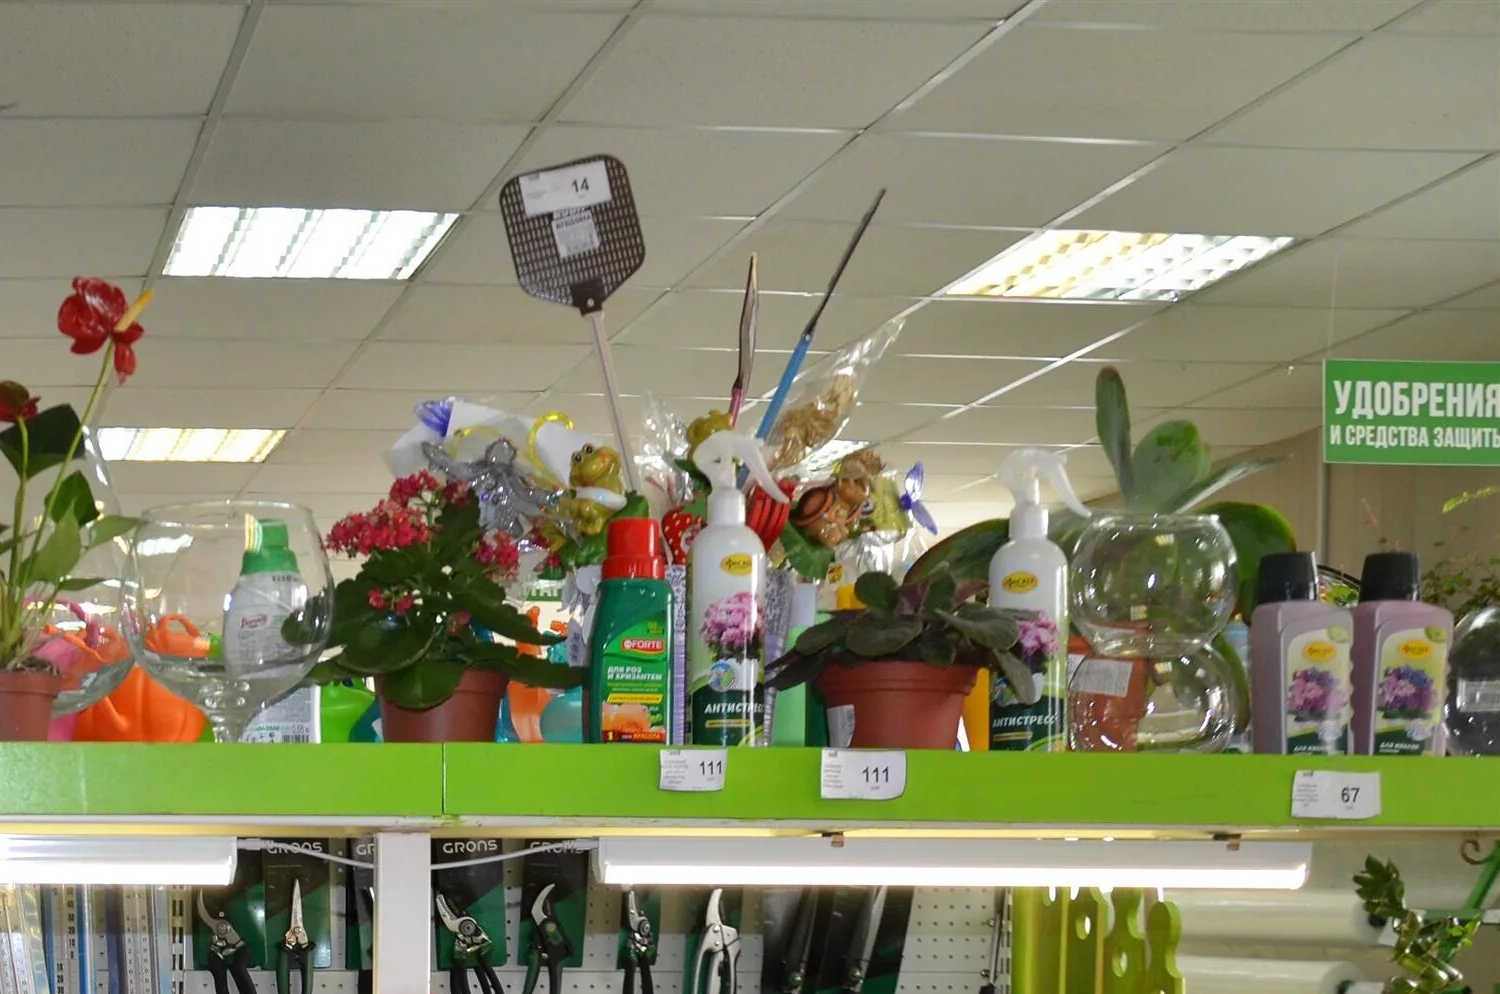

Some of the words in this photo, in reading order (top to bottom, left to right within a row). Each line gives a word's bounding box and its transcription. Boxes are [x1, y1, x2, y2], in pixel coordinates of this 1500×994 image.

[571, 177, 590, 193] 14
[1333, 380, 1500, 420] УДОБРЕНИЯ
[1330, 424, 1341, 445] И
[1345, 424, 1429, 449] СРЕДСТВА
[699, 760, 722, 776] 111
[862, 766, 890, 783] 111
[1341, 787, 1360, 803] 67
[442, 839, 498, 854] GRONS
